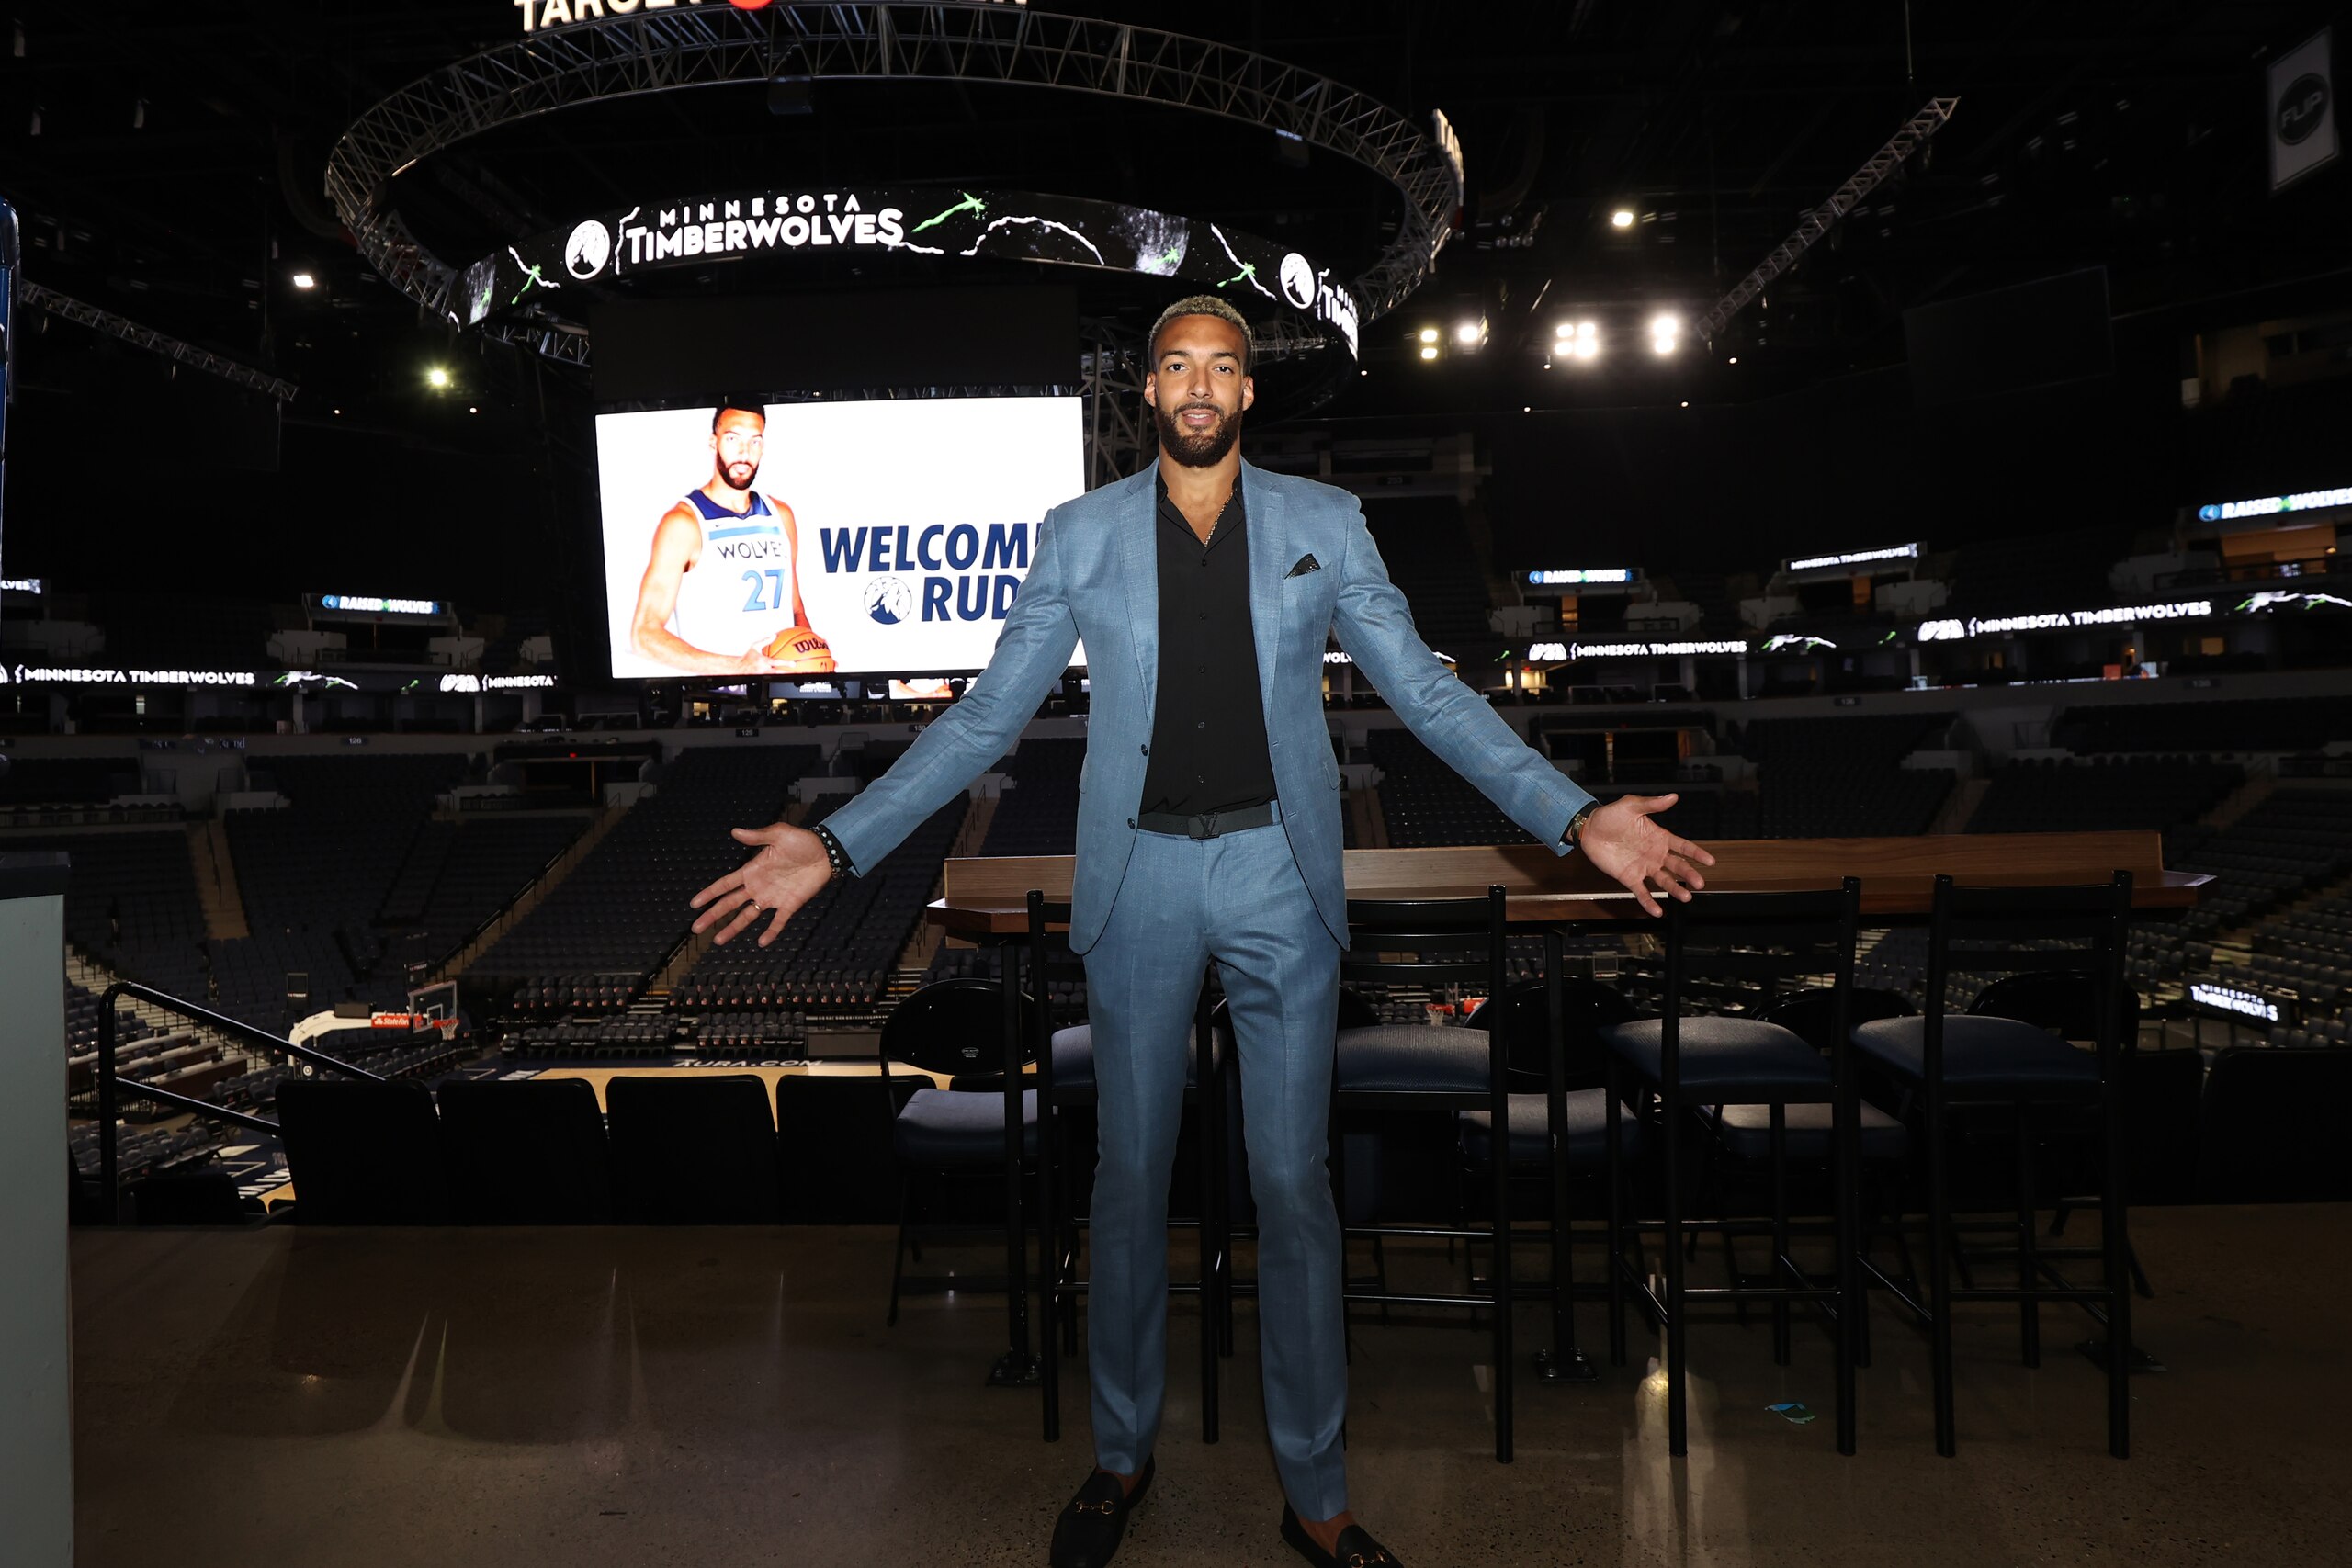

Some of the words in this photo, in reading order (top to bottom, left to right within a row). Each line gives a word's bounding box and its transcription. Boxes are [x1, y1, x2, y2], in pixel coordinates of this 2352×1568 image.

[2279, 90, 2324, 130] FLIP
[660, 193, 861, 228] MINNESOTA
[625, 208, 904, 264] TIMBERWOLVES
[717, 540, 787, 559] WOLVE
[741, 569, 785, 612] 27
[922, 574, 1026, 622] RUD
[1976, 612, 2071, 634] MINNESOTA
[2071, 601, 2211, 626] TIMBERWOLVES
[1577, 643, 1648, 658] MINNESOTA
[1649, 640, 1747, 655] TIMBERWOLVES
[24, 668, 127, 683] MINNESOTA
[128, 670, 255, 685] TIMBERWOLVES
[488, 675, 554, 688] MINNESOTA
